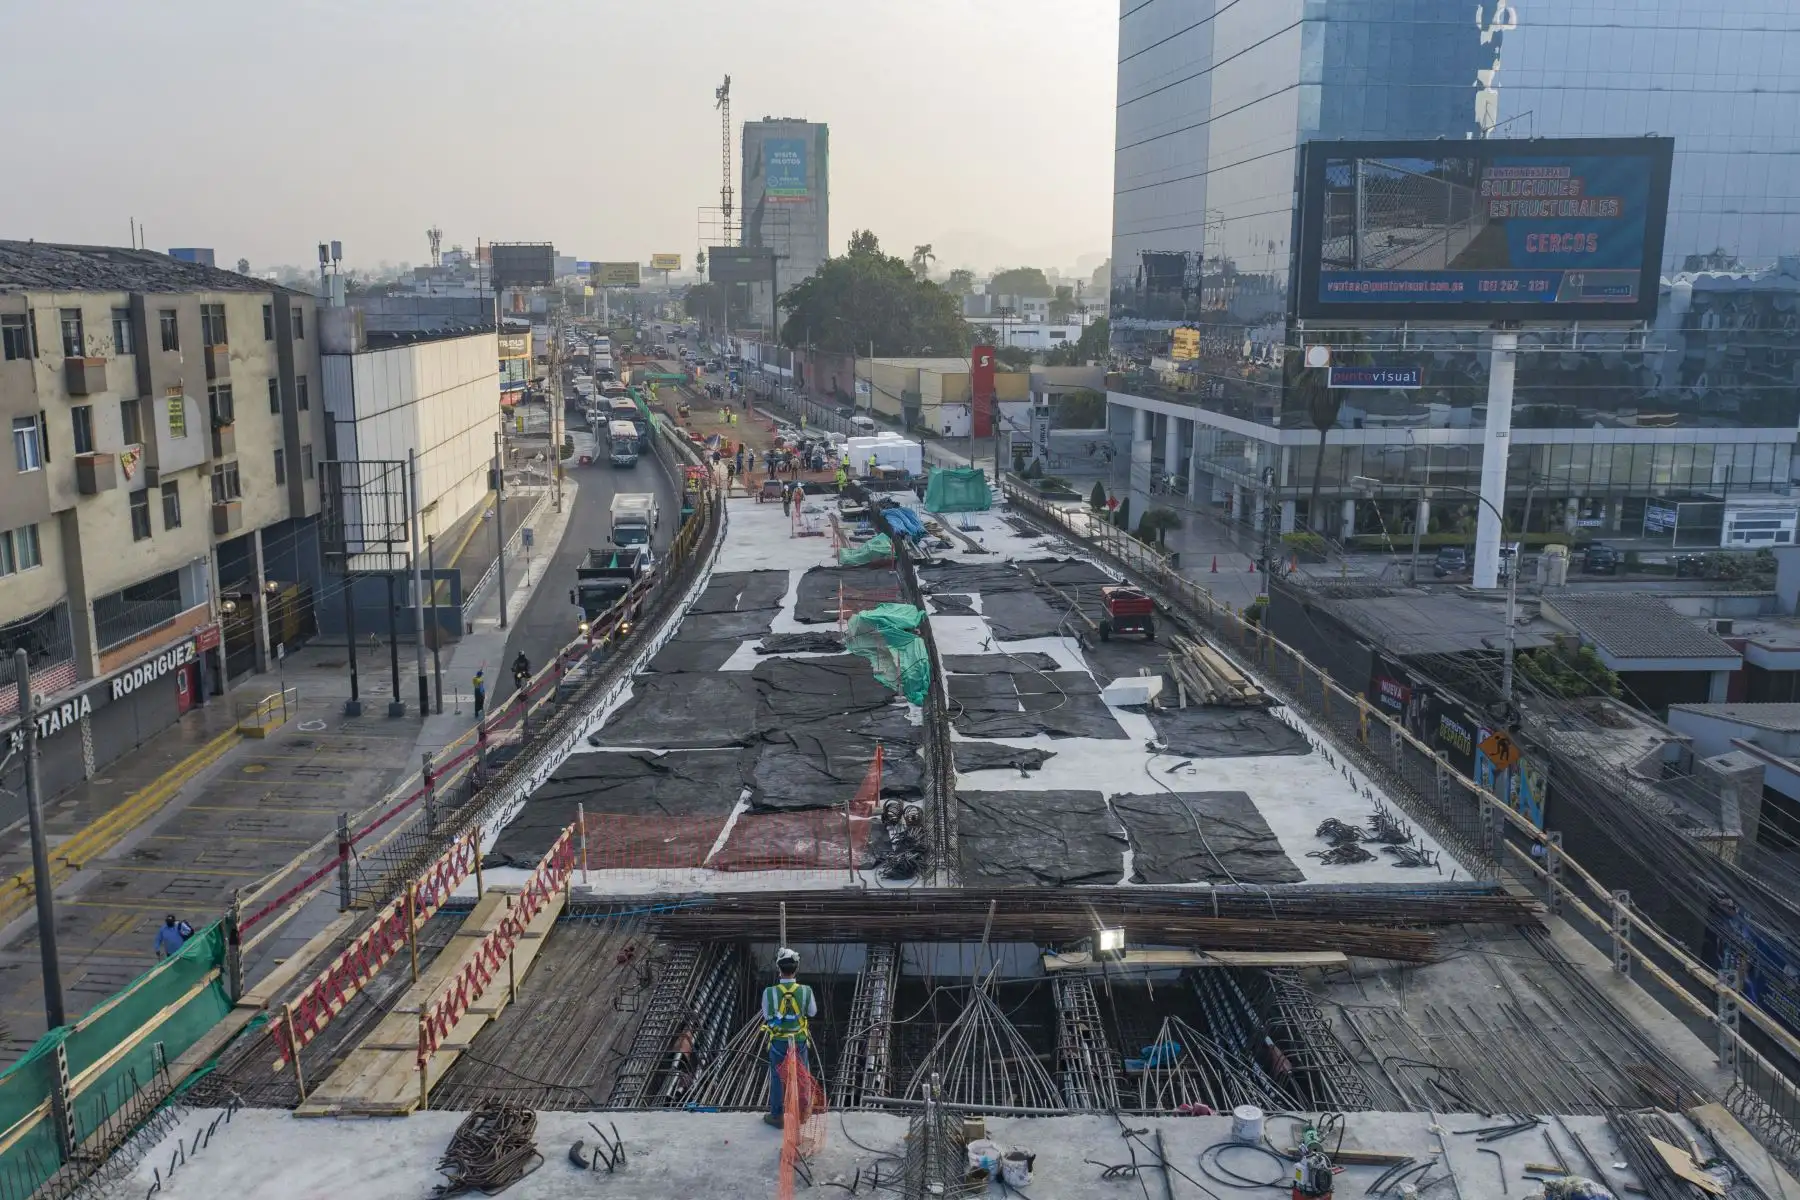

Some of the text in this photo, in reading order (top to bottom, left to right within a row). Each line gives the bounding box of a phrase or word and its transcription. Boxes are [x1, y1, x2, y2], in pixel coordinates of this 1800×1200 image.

[1481, 179, 1580, 197] SOLUCIONES
[1490, 199, 1619, 217] ESTRUCTURALES
[1526, 233, 1598, 253] CERCOS
[1333, 371, 1417, 384] puntovisual
[11, 640, 195, 751] NTARIA RODRIGUEZ
